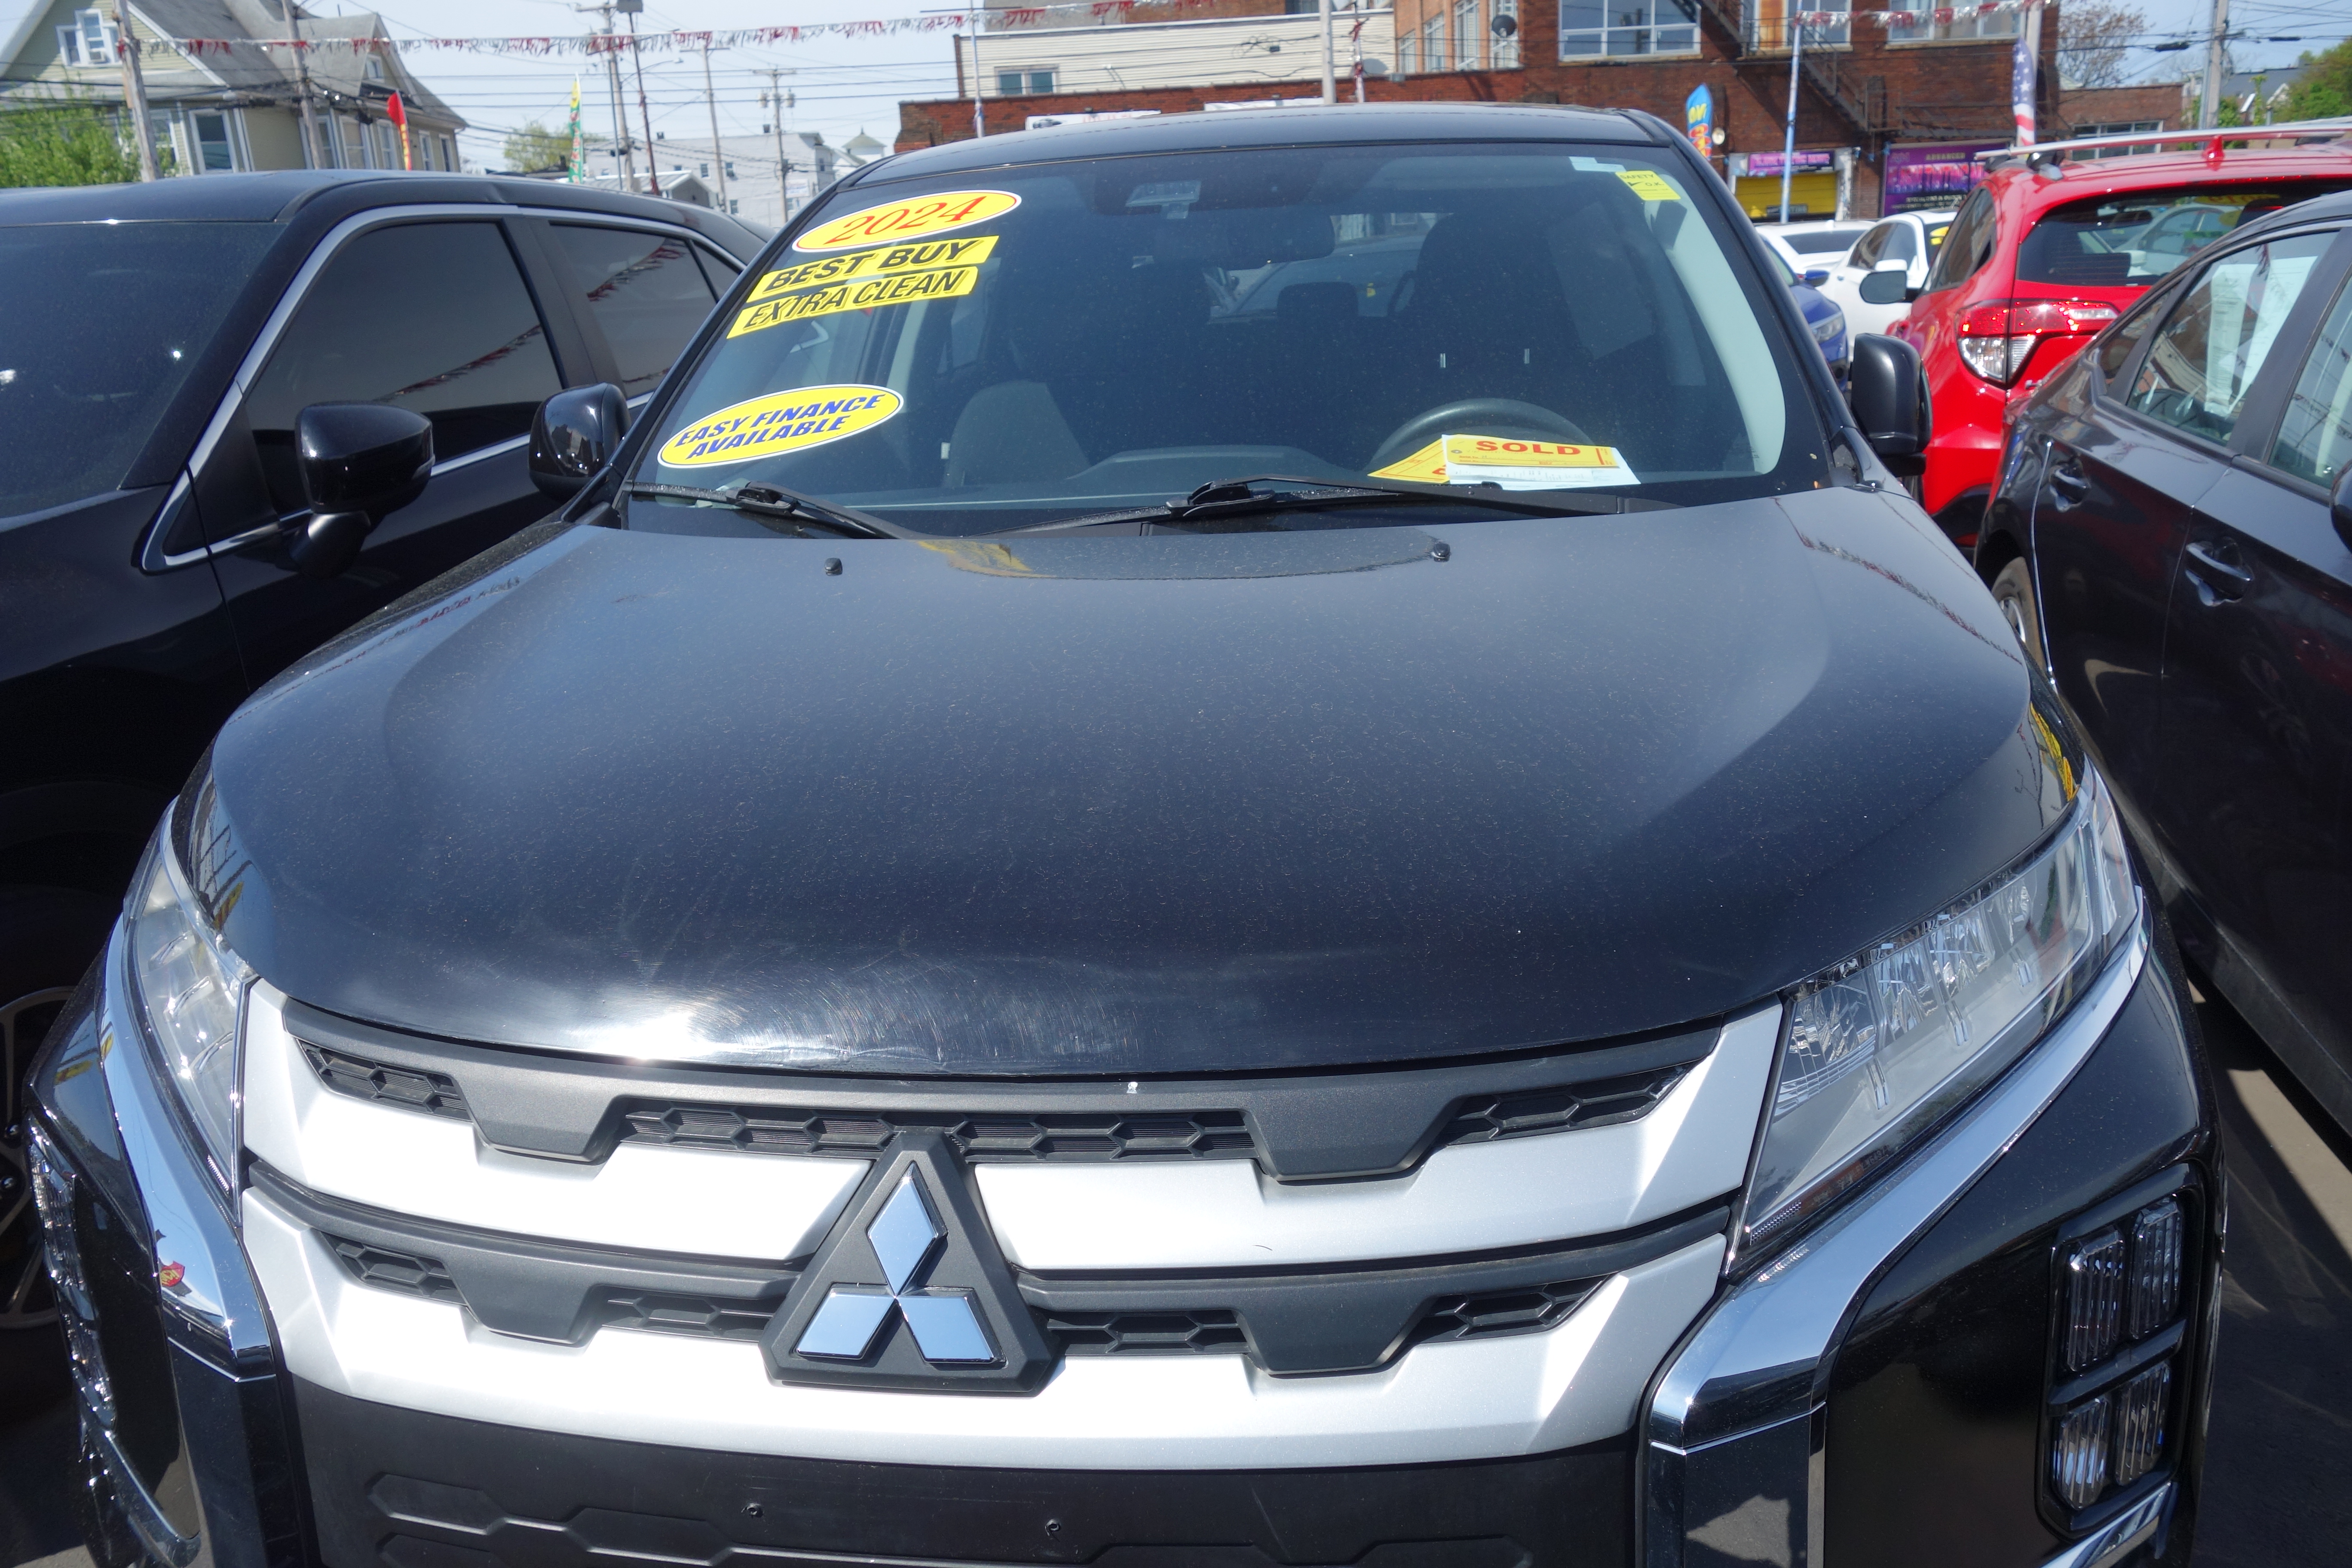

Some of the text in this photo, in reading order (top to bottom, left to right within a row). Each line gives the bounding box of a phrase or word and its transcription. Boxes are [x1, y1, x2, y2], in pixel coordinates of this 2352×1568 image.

[823, 196, 988, 245] 2024
[763, 239, 980, 293] BEST BUY
[743, 270, 966, 330] EXTRA CLEAN
[675, 394, 885, 447] EASY FINANCE
[686, 416, 850, 460] AVAILABLE
[1476, 440, 1581, 455] SOLD
